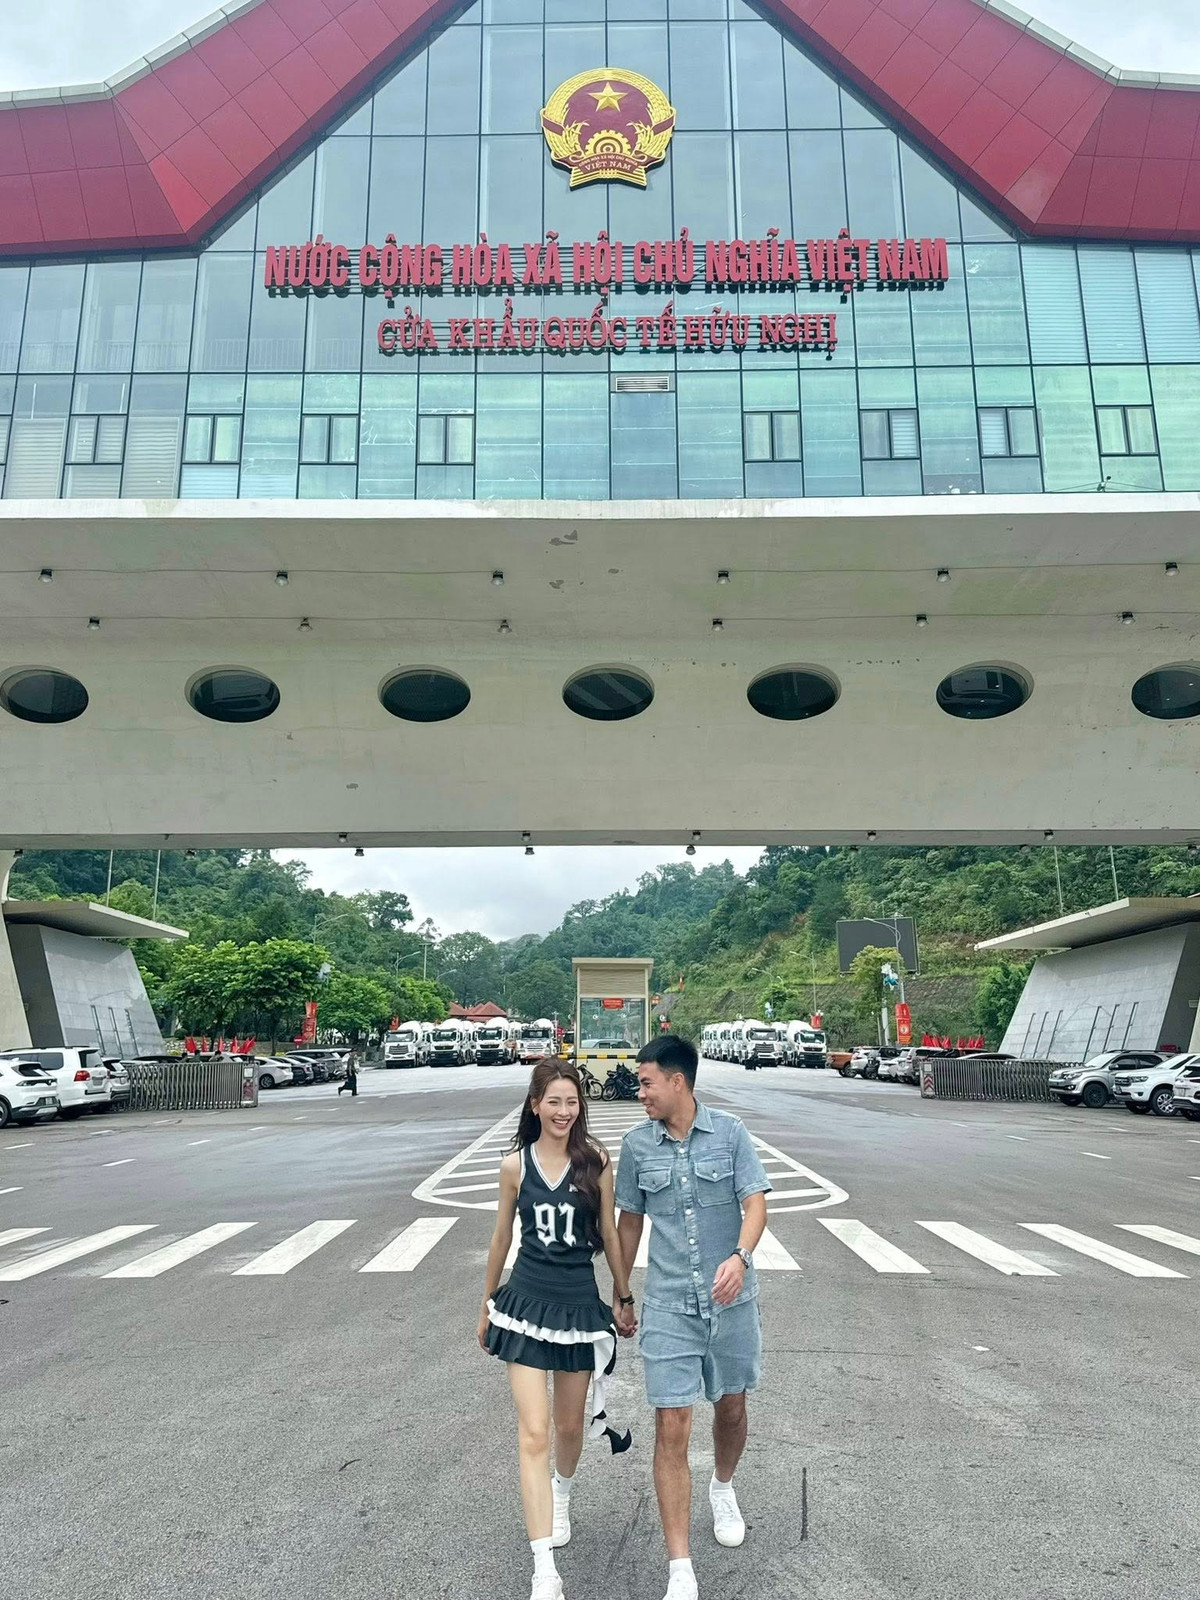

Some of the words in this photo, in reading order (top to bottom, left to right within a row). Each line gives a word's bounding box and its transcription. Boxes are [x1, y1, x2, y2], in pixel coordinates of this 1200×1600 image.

[584, 160, 608, 171] VIỆT
[609, 160, 633, 171] NAM
[264, 233, 350, 288] NƯỚC
[358, 232, 445, 299] CỘNG
[451, 231, 515, 286] HÒA
[521, 230, 563, 286] XÃ
[572, 229, 624, 296] HỘI
[633, 226, 694, 283] CHỦ
[704, 227, 800, 283] NGHĨA
[805, 227, 872, 293] VIỆT
[876, 237, 950, 282] NAM
[377, 305, 438, 350] CỬA
[447, 298, 540, 349] KHẨU
[543, 300, 628, 350] QUỐC
[636, 300, 677, 347] TẾ
[683, 306, 751, 346] HỮU
[759, 313, 839, 352] NGHỊ
[532, 1201, 577, 1247] 91
